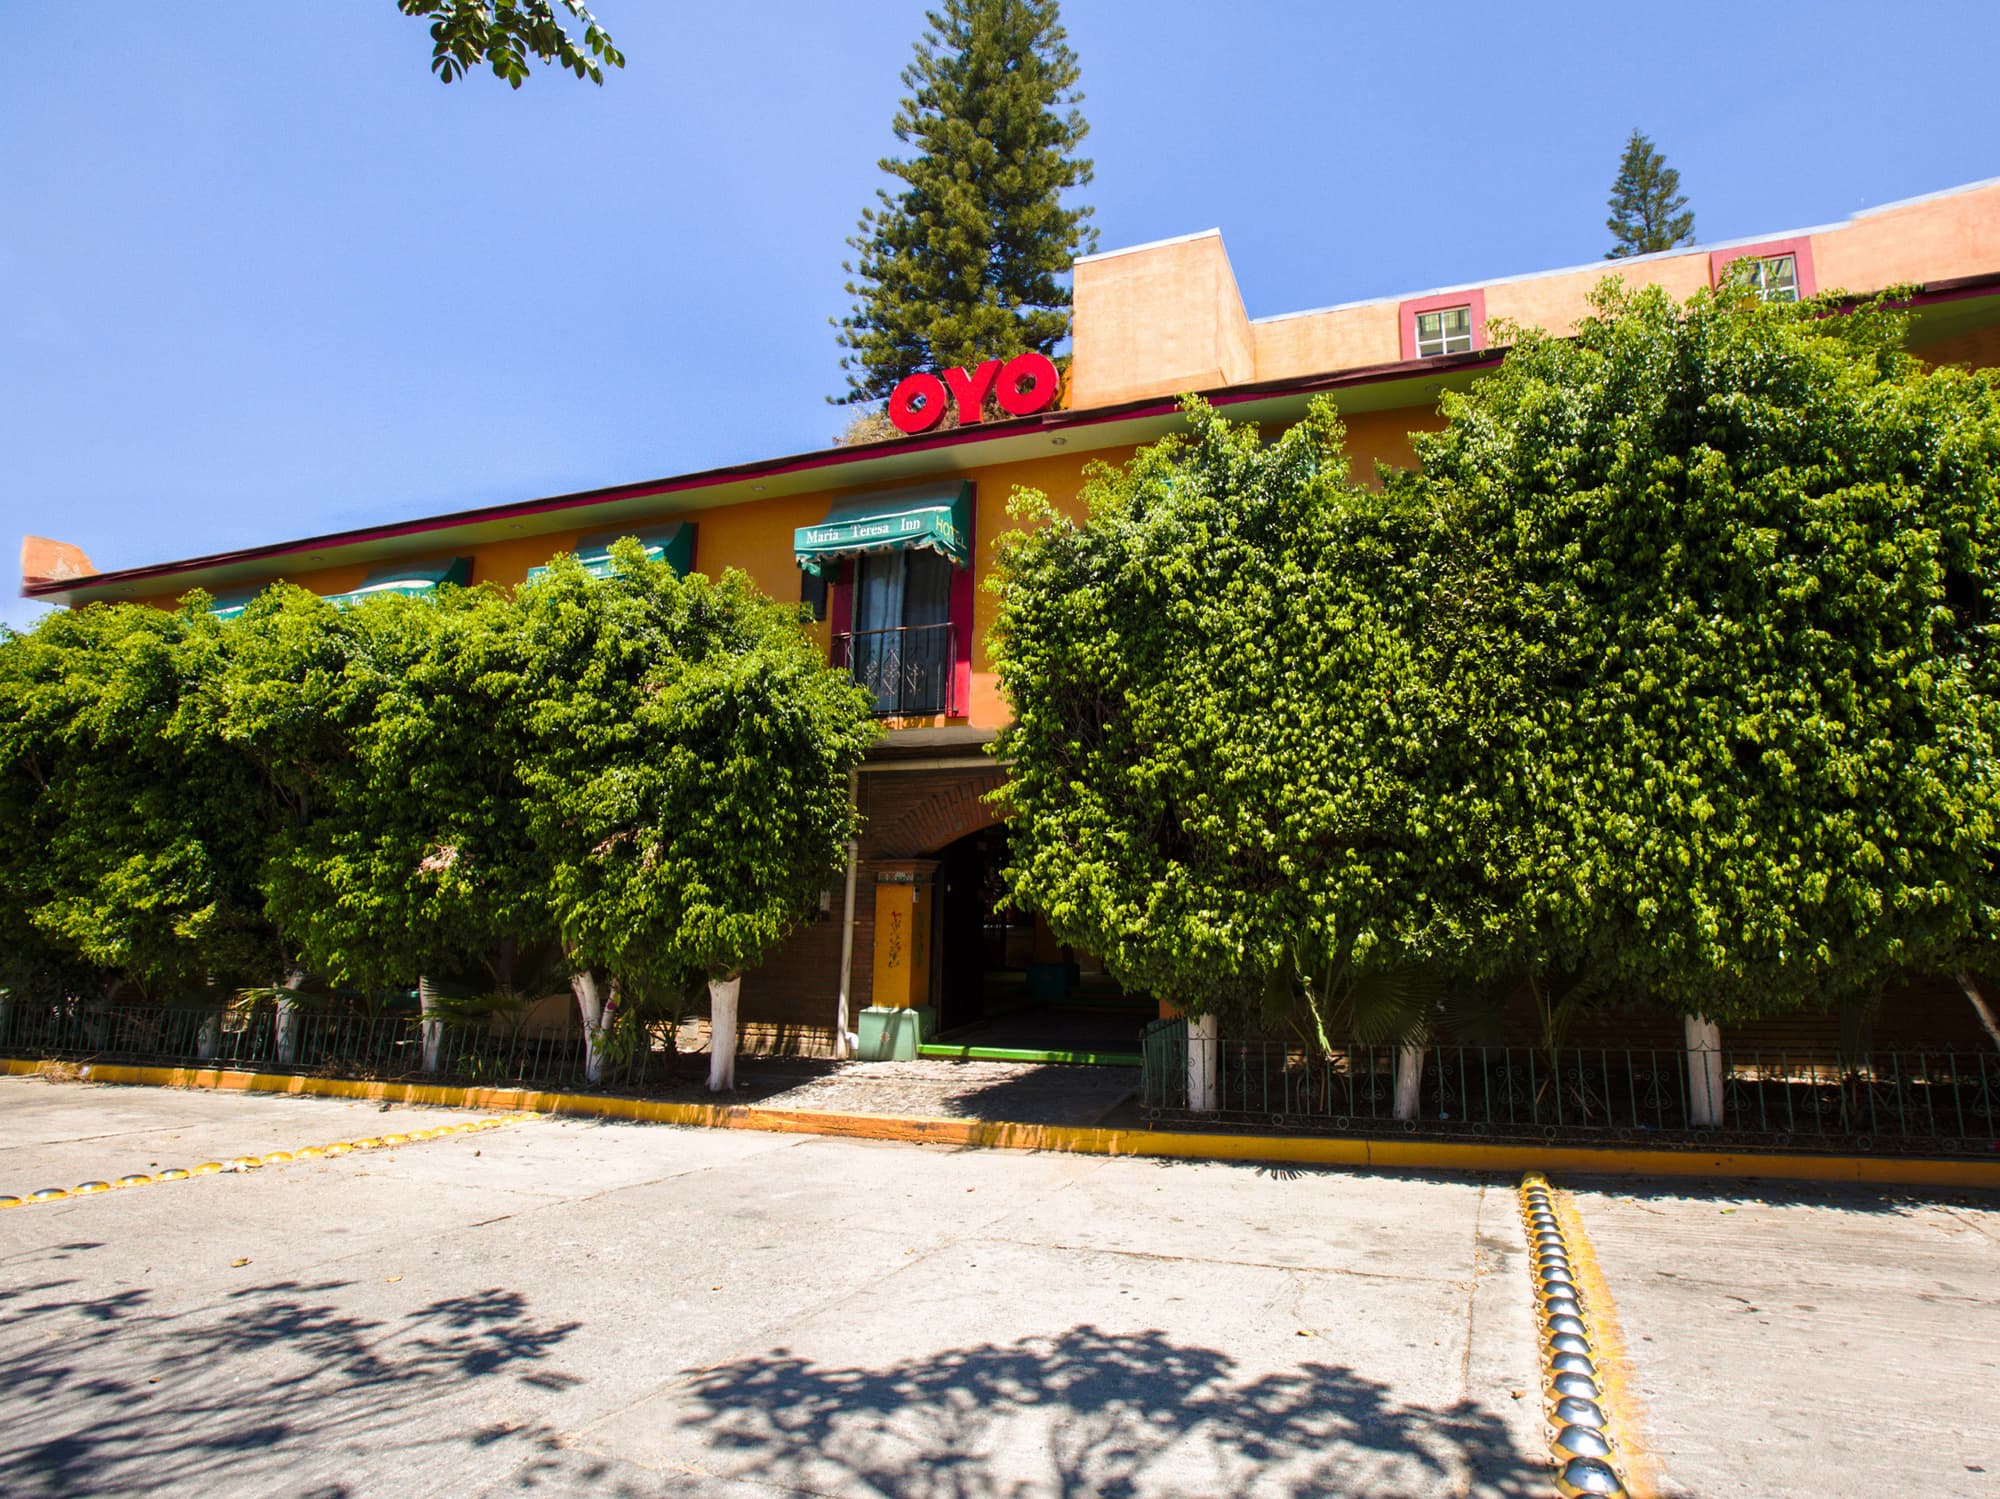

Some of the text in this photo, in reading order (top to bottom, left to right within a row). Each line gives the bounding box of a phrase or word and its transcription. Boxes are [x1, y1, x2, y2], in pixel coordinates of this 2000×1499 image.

[889, 353, 1059, 434] OYO
[851, 523, 889, 537] Teresa
[900, 517, 921, 532] Inn
